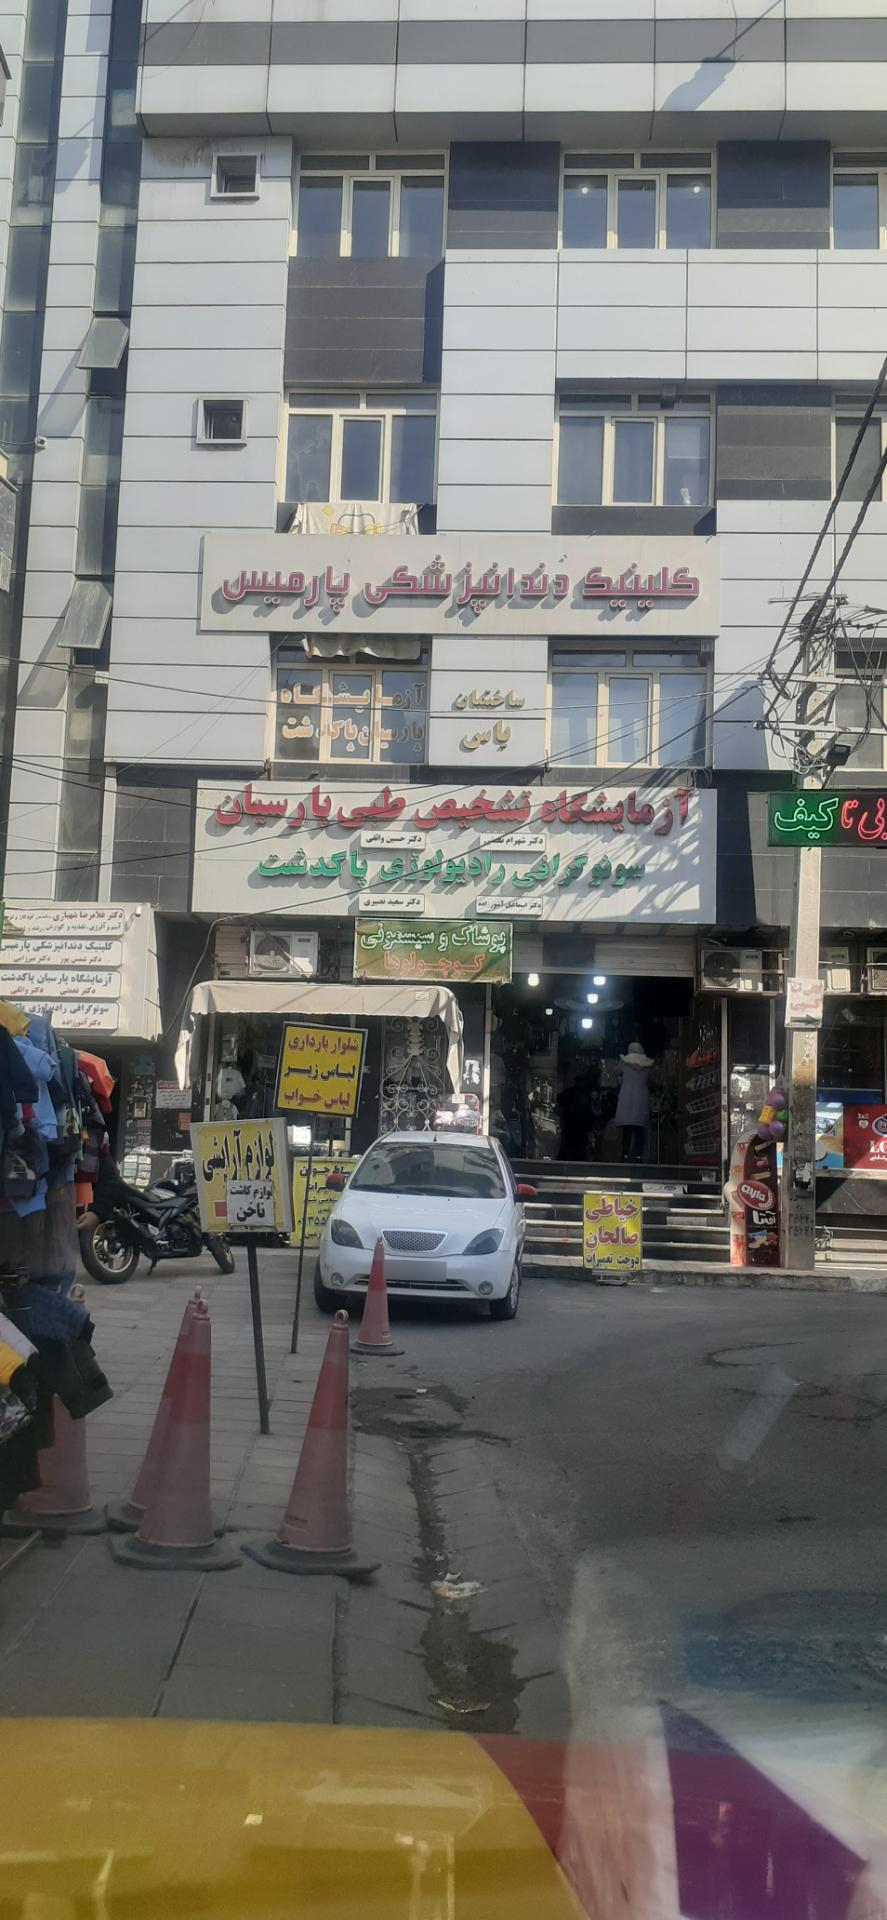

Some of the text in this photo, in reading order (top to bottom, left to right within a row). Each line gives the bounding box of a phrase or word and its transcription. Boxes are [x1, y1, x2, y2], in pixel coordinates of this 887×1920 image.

[222, 554, 700, 615] کلینیک دندانپزشکی پارمیس
[453, 687, 526, 711] ساختمان
[214, 782, 695, 836] آزمایشگاه تشخیص طبی پارسیان
[774, 797, 840, 840] کیف
[840, 799, 859, 829] تا
[386, 836, 405, 844] حسین
[407, 834, 422, 845] دکتر
[528, 837, 543, 847] دکتر
[257, 848, 646, 889] سونوگرافی رادیولوژی پاکدشت
[406, 897, 420, 907] دکتر
[528, 901, 542, 910] دکتر
[108, 911, 123, 920] دکتر
[33, 940, 82, 952] دندانپزشکی
[84, 941, 113, 952] کلینیک
[437, 931, 449, 952] و
[451, 924, 507, 954] پوشاک
[1, 972, 34, 985] پاکدشت
[71, 973, 113, 987] آزمایشگاه
[288, 1034, 359, 1055] شلوار بارداری
[284, 1063, 356, 1082] لباس زیر
[284, 1088, 351, 1110] لباس خواب
[246, 1130, 275, 1180] لوازم
[230, 1184, 272, 1200] لوازم کاشت
[236, 1201, 266, 1222] ناخن
[586, 1198, 638, 1222] خیاطی
[586, 1226, 639, 1249] صالحان
